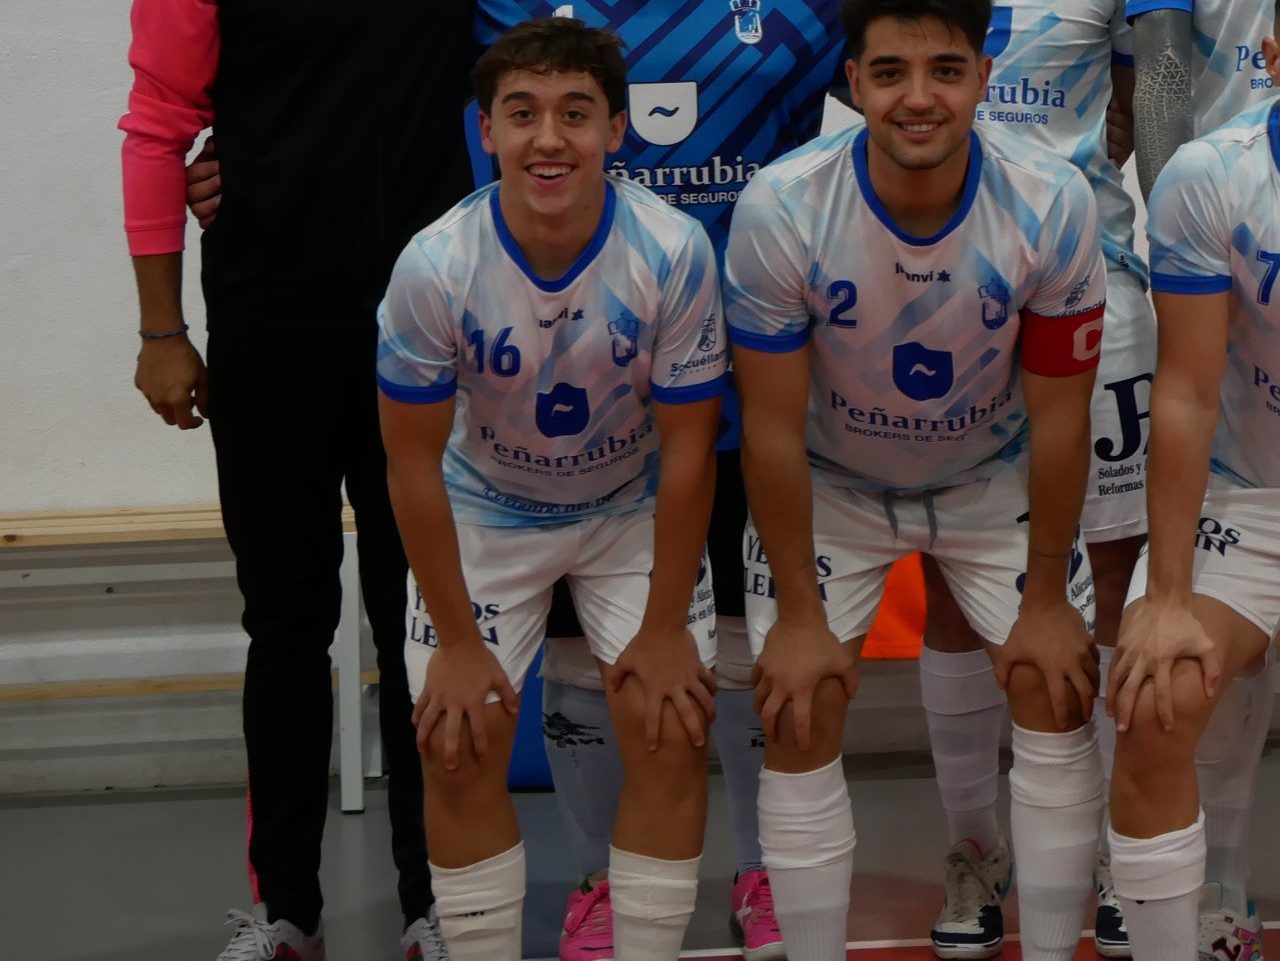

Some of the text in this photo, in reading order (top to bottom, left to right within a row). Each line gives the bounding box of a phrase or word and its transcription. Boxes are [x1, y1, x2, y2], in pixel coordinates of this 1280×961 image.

[985, 78, 1066, 108] rubia
[989, 111, 1049, 125] SEGUROS
[604, 155, 761, 187] ñarrubia
[826, 280, 857, 328] 2
[468, 326, 521, 377] 16
[1072, 319, 1102, 362] C
[831, 389, 1012, 433] Peñarrubia
[480, 423, 653, 469] Peñarrubia
[845, 423, 935, 443] BROKERS DE
[491, 447, 640, 478] ROKERS DE SEGUROS
[1098, 463, 1142, 480] Solados y
[1098, 479, 1144, 497] Reformas
[747, 535, 832, 577] YES
